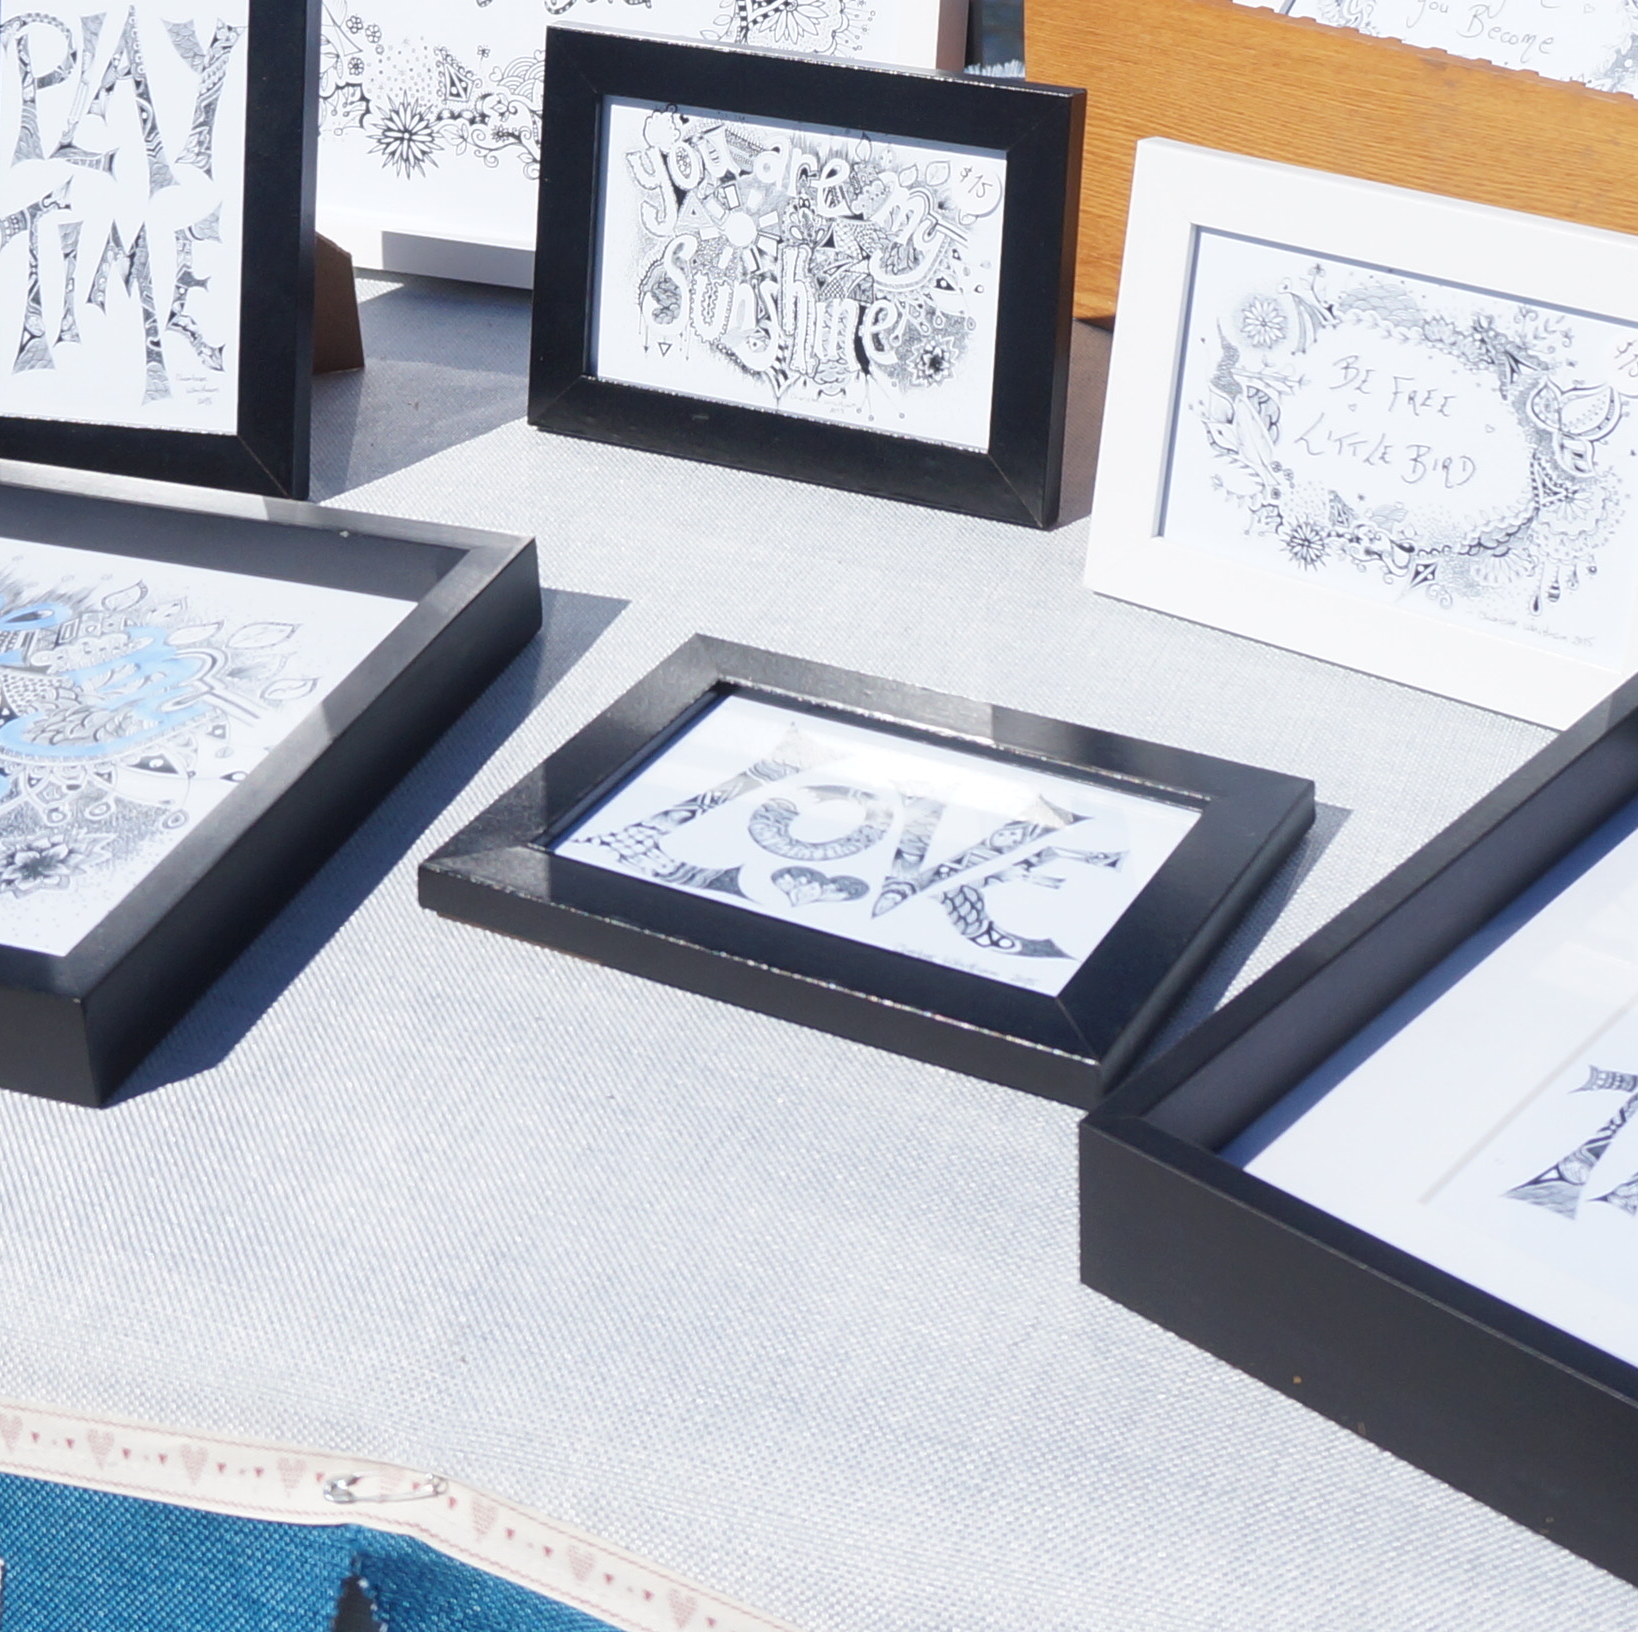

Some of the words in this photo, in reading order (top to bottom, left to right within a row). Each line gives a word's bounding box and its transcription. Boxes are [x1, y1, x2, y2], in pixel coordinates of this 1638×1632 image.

[1465, 3, 1555, 58] Become
[754, 135, 852, 218] are
[959, 165, 989, 198] $15
[1329, 352, 1373, 397] BE
[1388, 374, 1455, 420] FREE
[1401, 440, 1477, 490] BIRD
[572, 720, 1129, 959] LOVE
